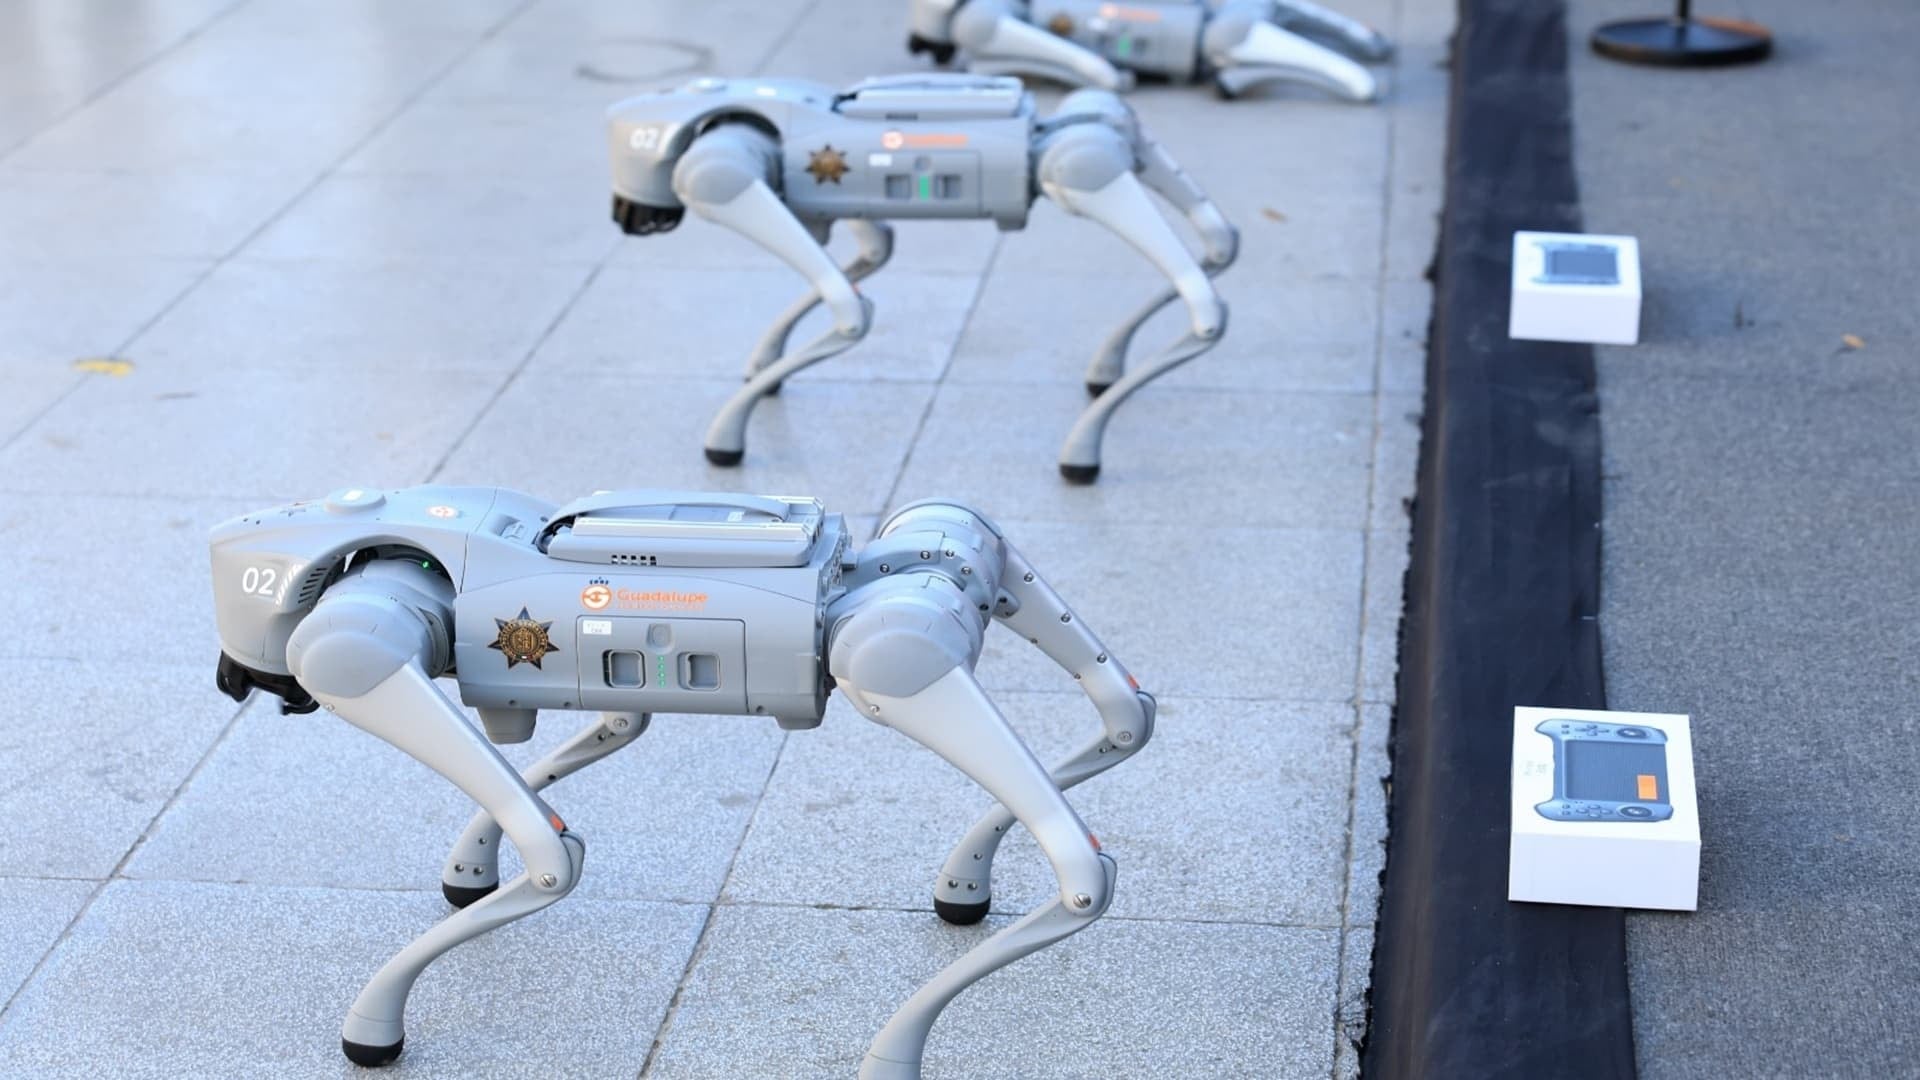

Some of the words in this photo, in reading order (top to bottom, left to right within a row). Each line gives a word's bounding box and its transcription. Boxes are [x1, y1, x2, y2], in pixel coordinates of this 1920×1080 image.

[630, 127, 658, 150] 02
[243, 567, 276, 595] 02
[617, 588, 707, 604] Guadalupe
